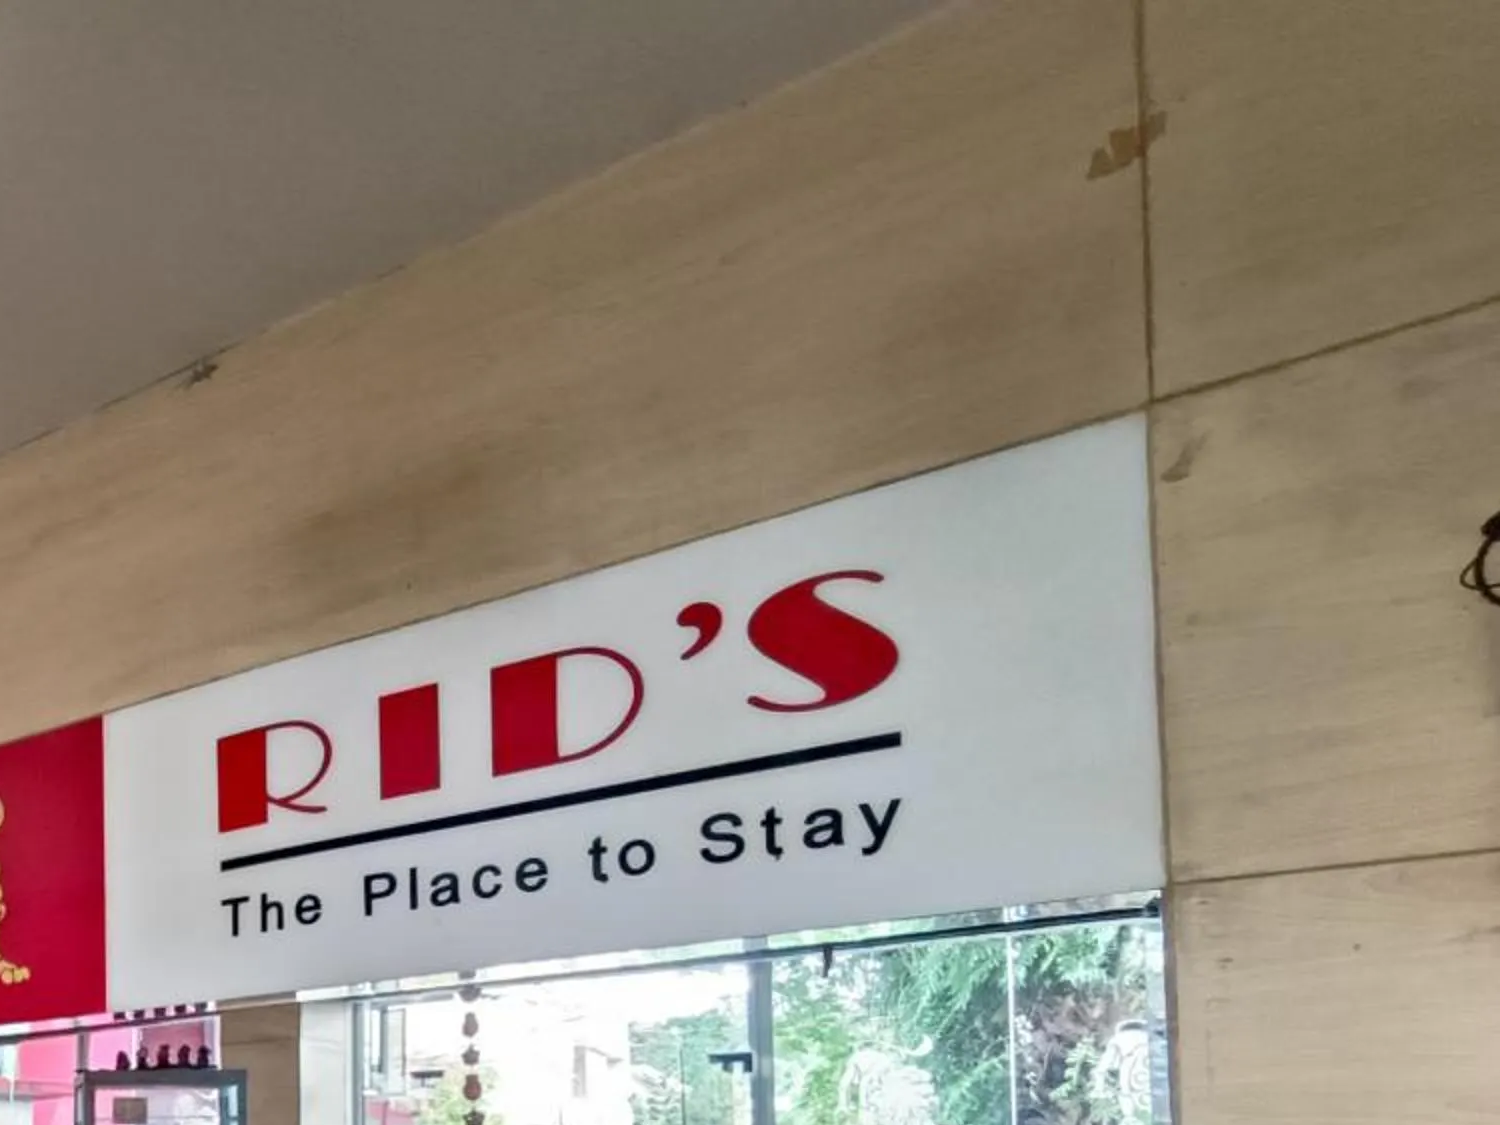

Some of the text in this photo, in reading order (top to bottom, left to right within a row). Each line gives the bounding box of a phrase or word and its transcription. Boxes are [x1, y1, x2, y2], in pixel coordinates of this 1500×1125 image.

[216, 569, 900, 834] RID'S
[220, 798, 902, 937] The Place to Stay
